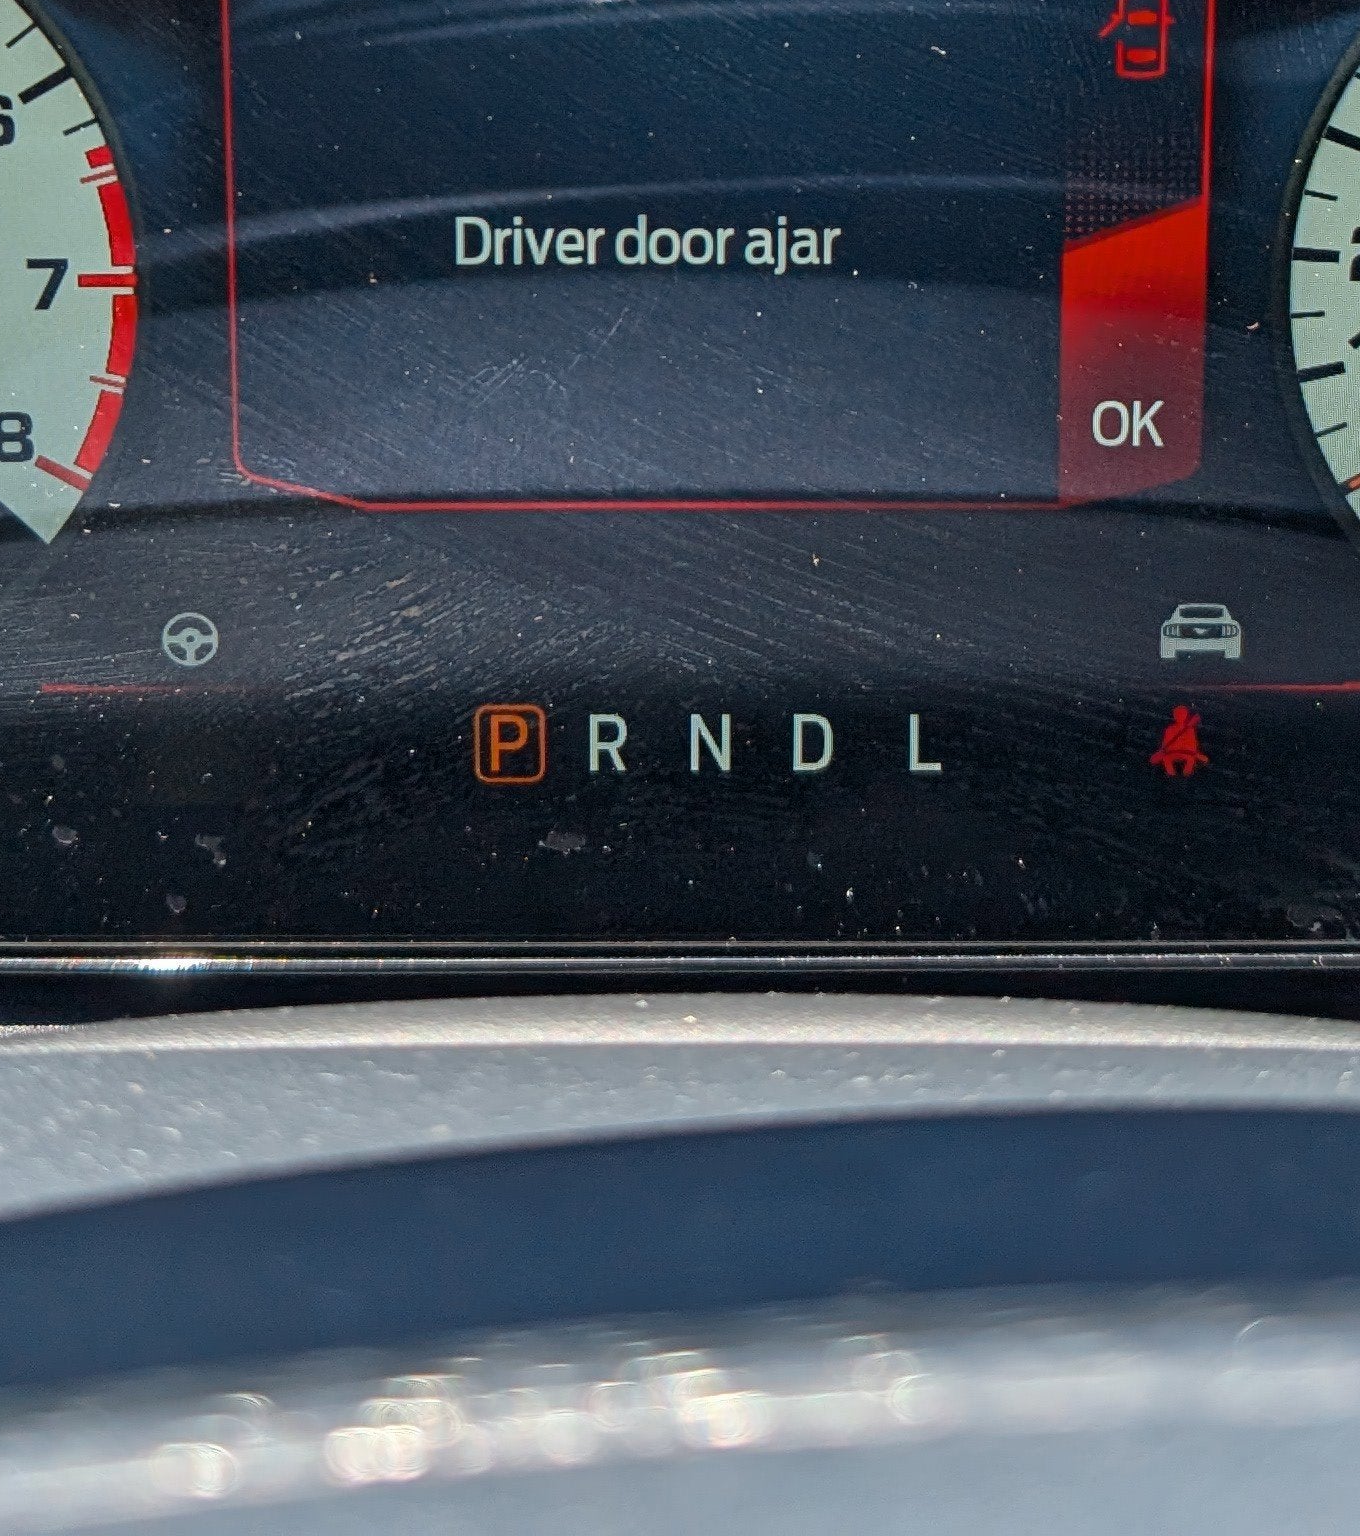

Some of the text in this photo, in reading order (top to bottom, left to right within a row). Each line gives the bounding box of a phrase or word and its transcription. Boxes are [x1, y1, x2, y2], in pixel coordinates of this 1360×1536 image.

[455, 213, 842, 276] Driver door ajar
[25, 258, 69, 311] 7
[1092, 400, 1165, 448] OK
[489, 712, 942, 772] P R N D L
